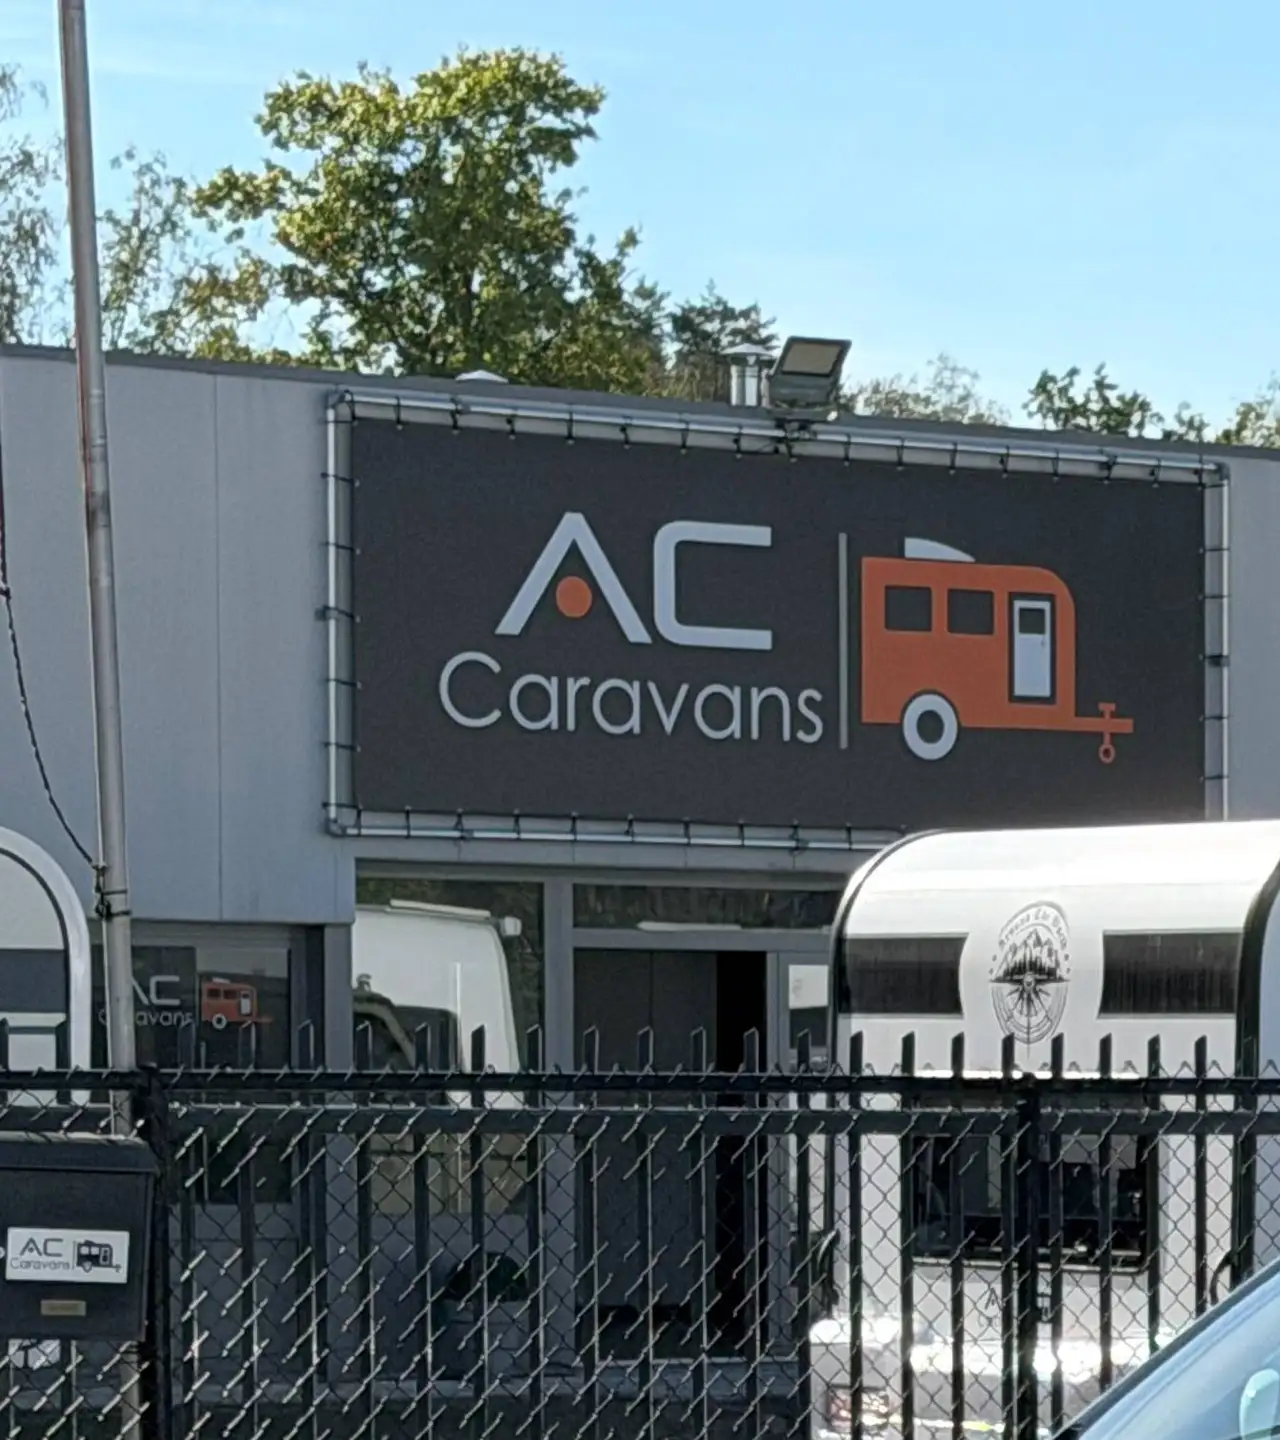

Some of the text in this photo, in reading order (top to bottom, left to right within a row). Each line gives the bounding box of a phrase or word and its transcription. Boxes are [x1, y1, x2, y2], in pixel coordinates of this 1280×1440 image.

[494, 511, 773, 651] AC
[438, 650, 824, 744] Caravans
[98, 1008, 194, 1027] Cavans
[19, 1237, 64, 1258] AC
[9, 1256, 71, 1271] Caravans
